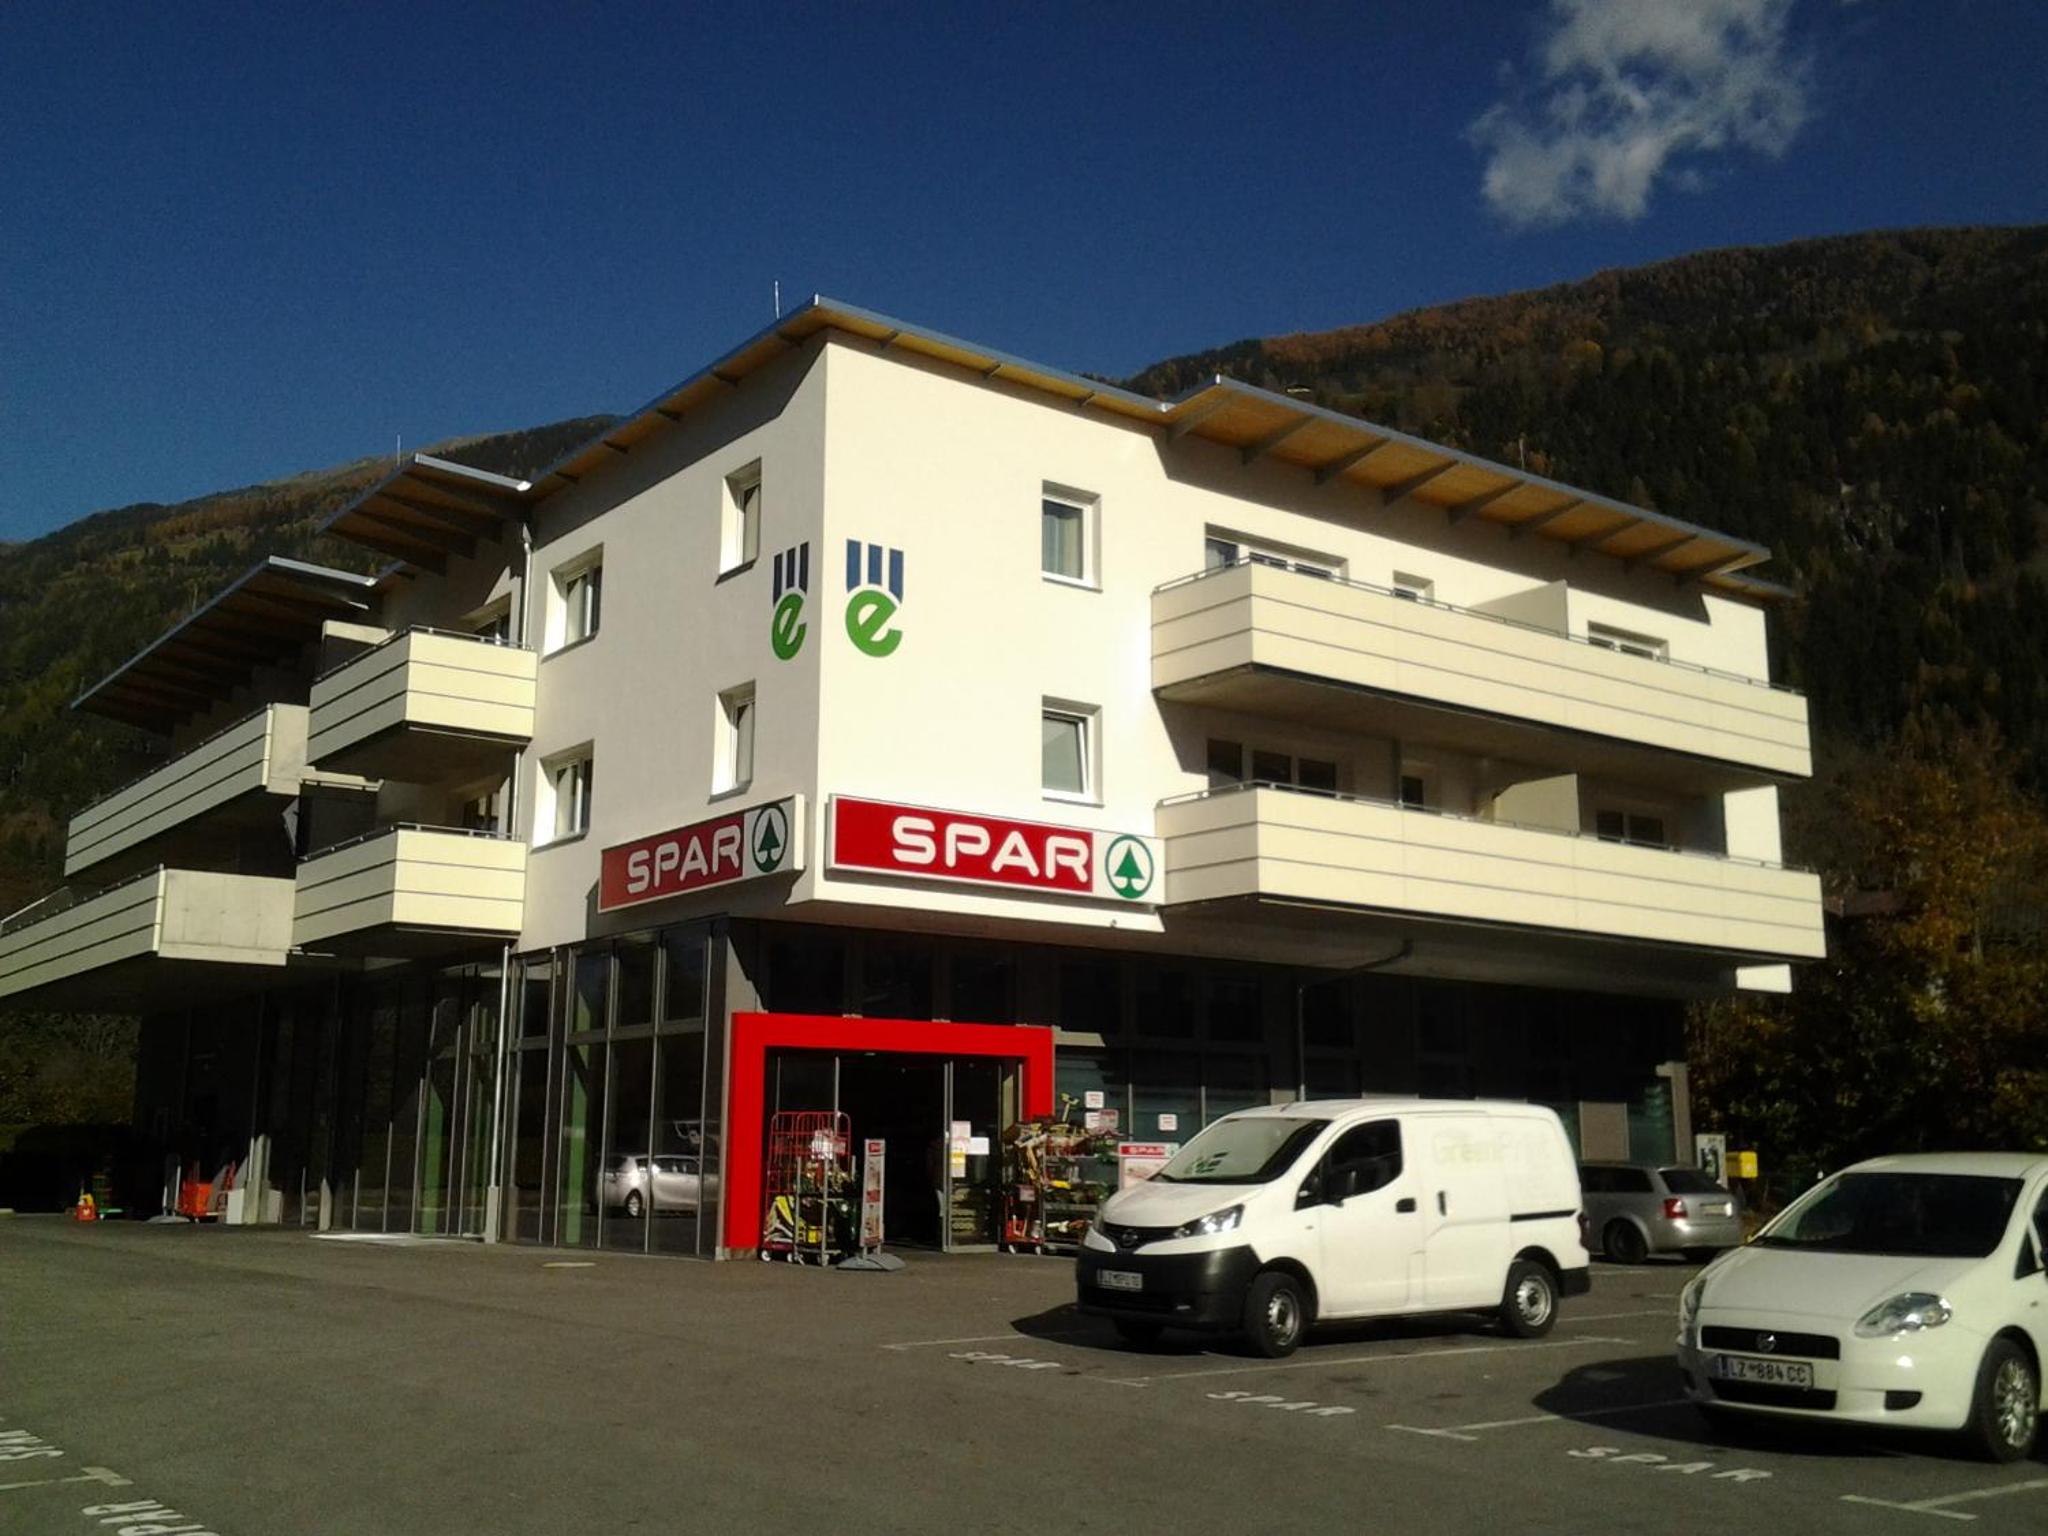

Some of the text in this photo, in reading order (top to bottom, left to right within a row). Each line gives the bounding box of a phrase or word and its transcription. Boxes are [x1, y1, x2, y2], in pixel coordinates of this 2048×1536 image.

[627, 825, 740, 893] SPAR
[892, 815, 1089, 883] SPAR
[1129, 1145, 1165, 1156] SPAR
[1206, 1391, 1356, 1416] SPAR
[1567, 1446, 1773, 1482] SPAR
